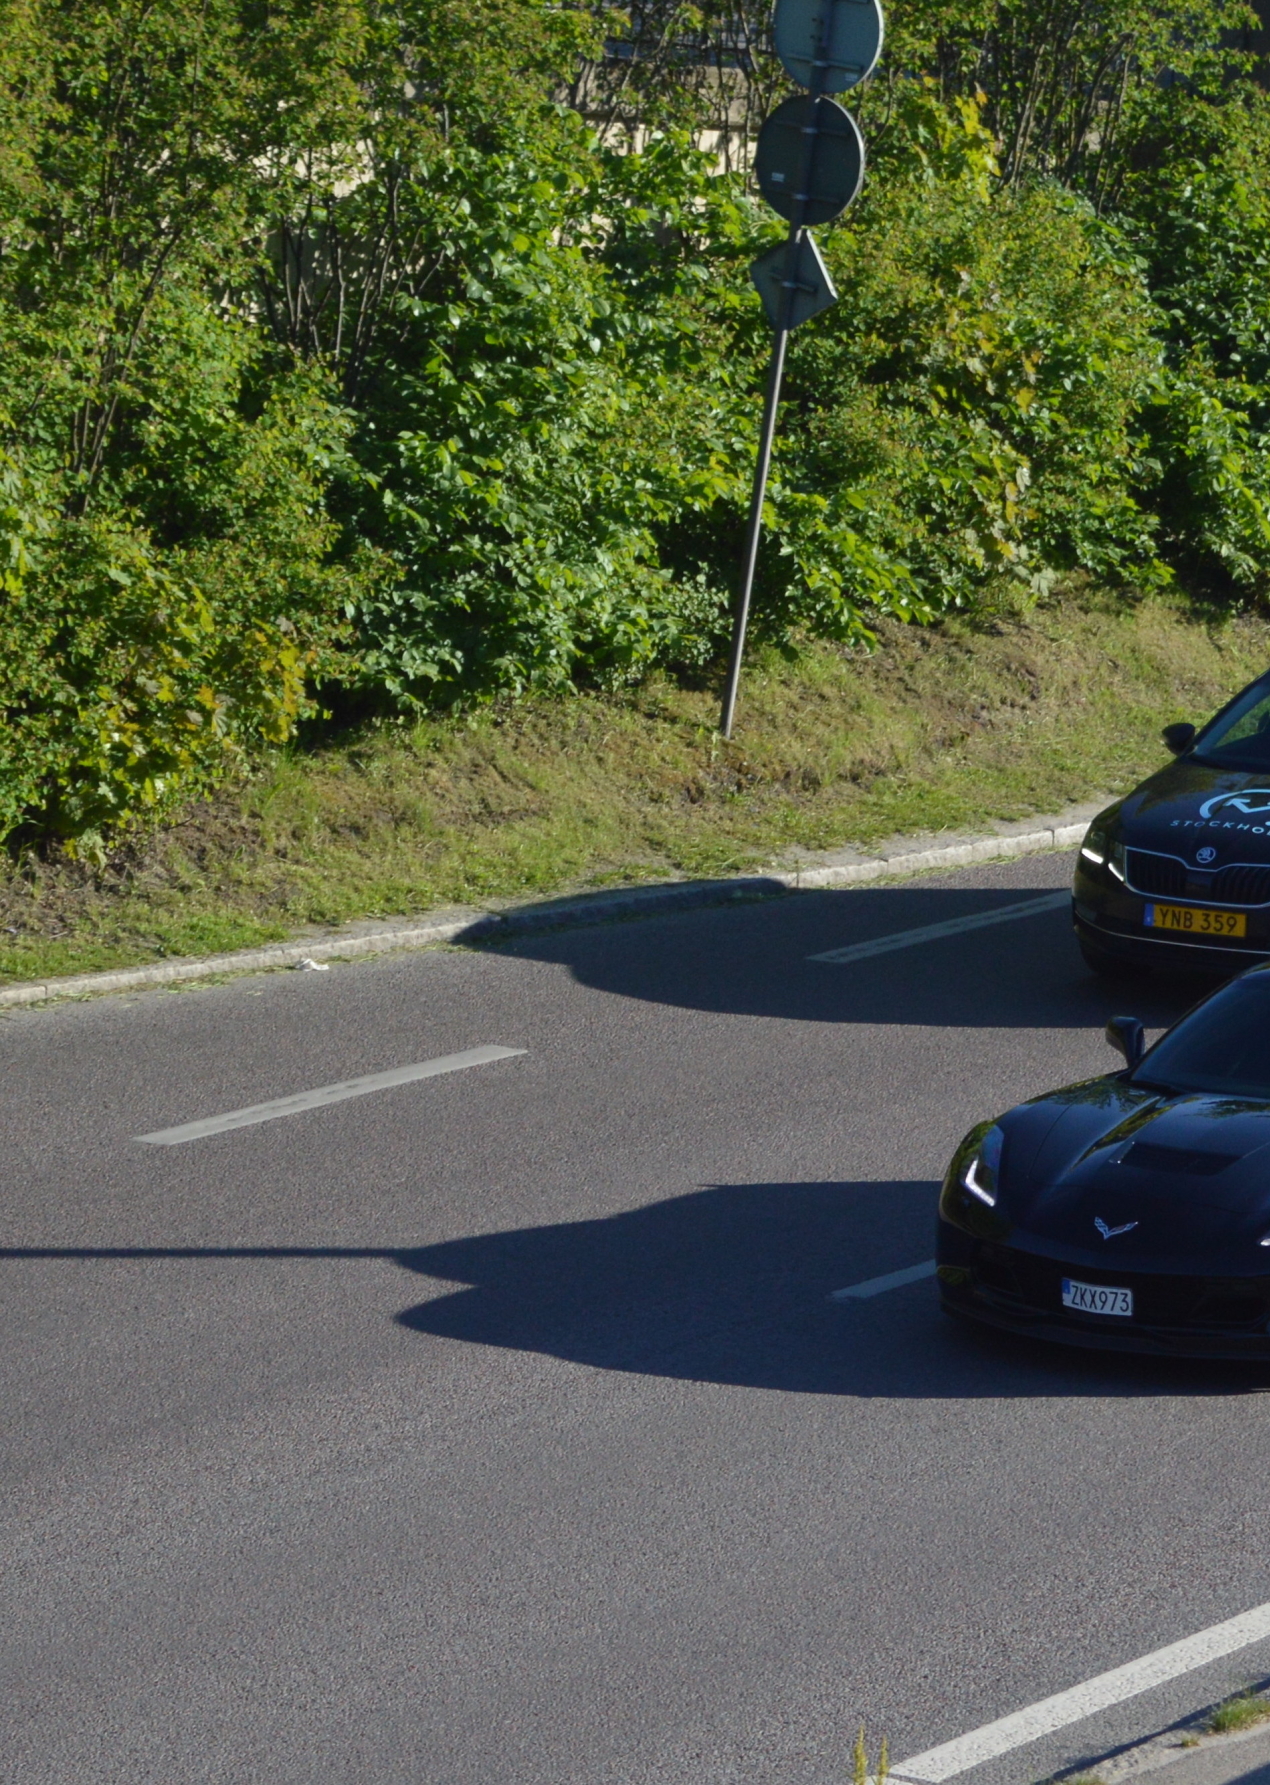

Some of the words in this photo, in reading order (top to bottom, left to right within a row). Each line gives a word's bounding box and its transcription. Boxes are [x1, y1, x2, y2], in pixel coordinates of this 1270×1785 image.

[1159, 907, 1194, 929] YNB
[1200, 912, 1238, 934] 359
[1071, 1284, 1130, 1313] ZKX973
